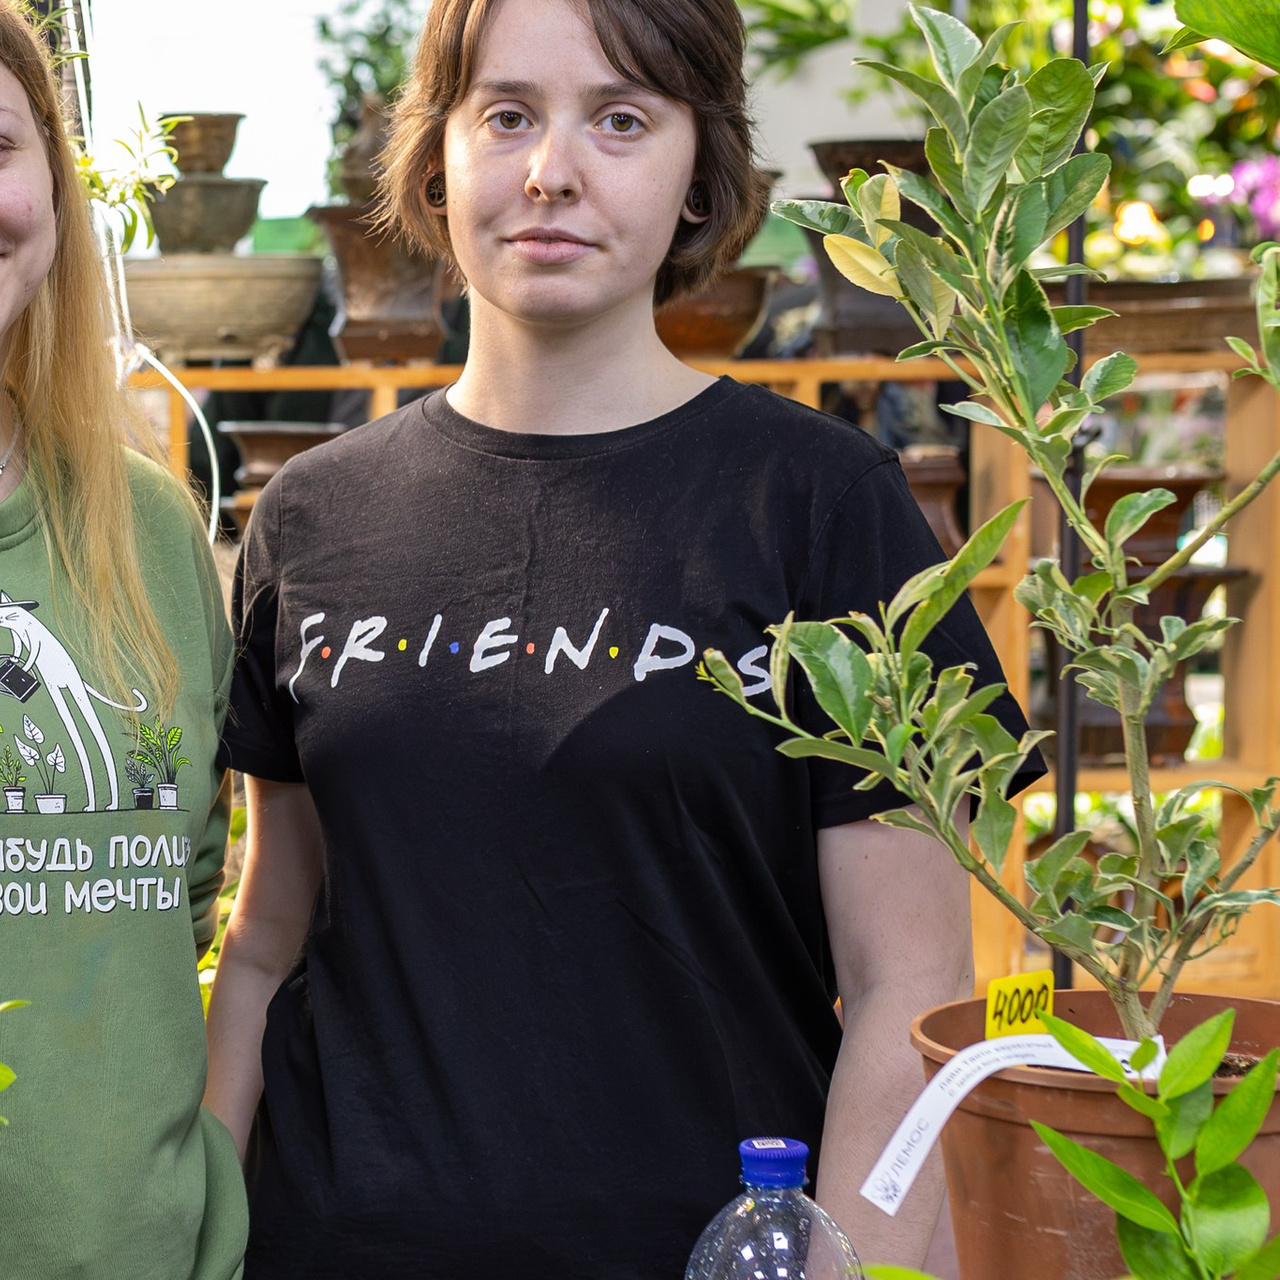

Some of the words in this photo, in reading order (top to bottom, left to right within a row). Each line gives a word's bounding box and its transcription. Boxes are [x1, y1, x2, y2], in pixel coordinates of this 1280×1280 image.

[64, 877, 181, 913] мечты
[993, 984, 1048, 1031] 4000
[890, 1117, 930, 1177] ЛЕМОС
